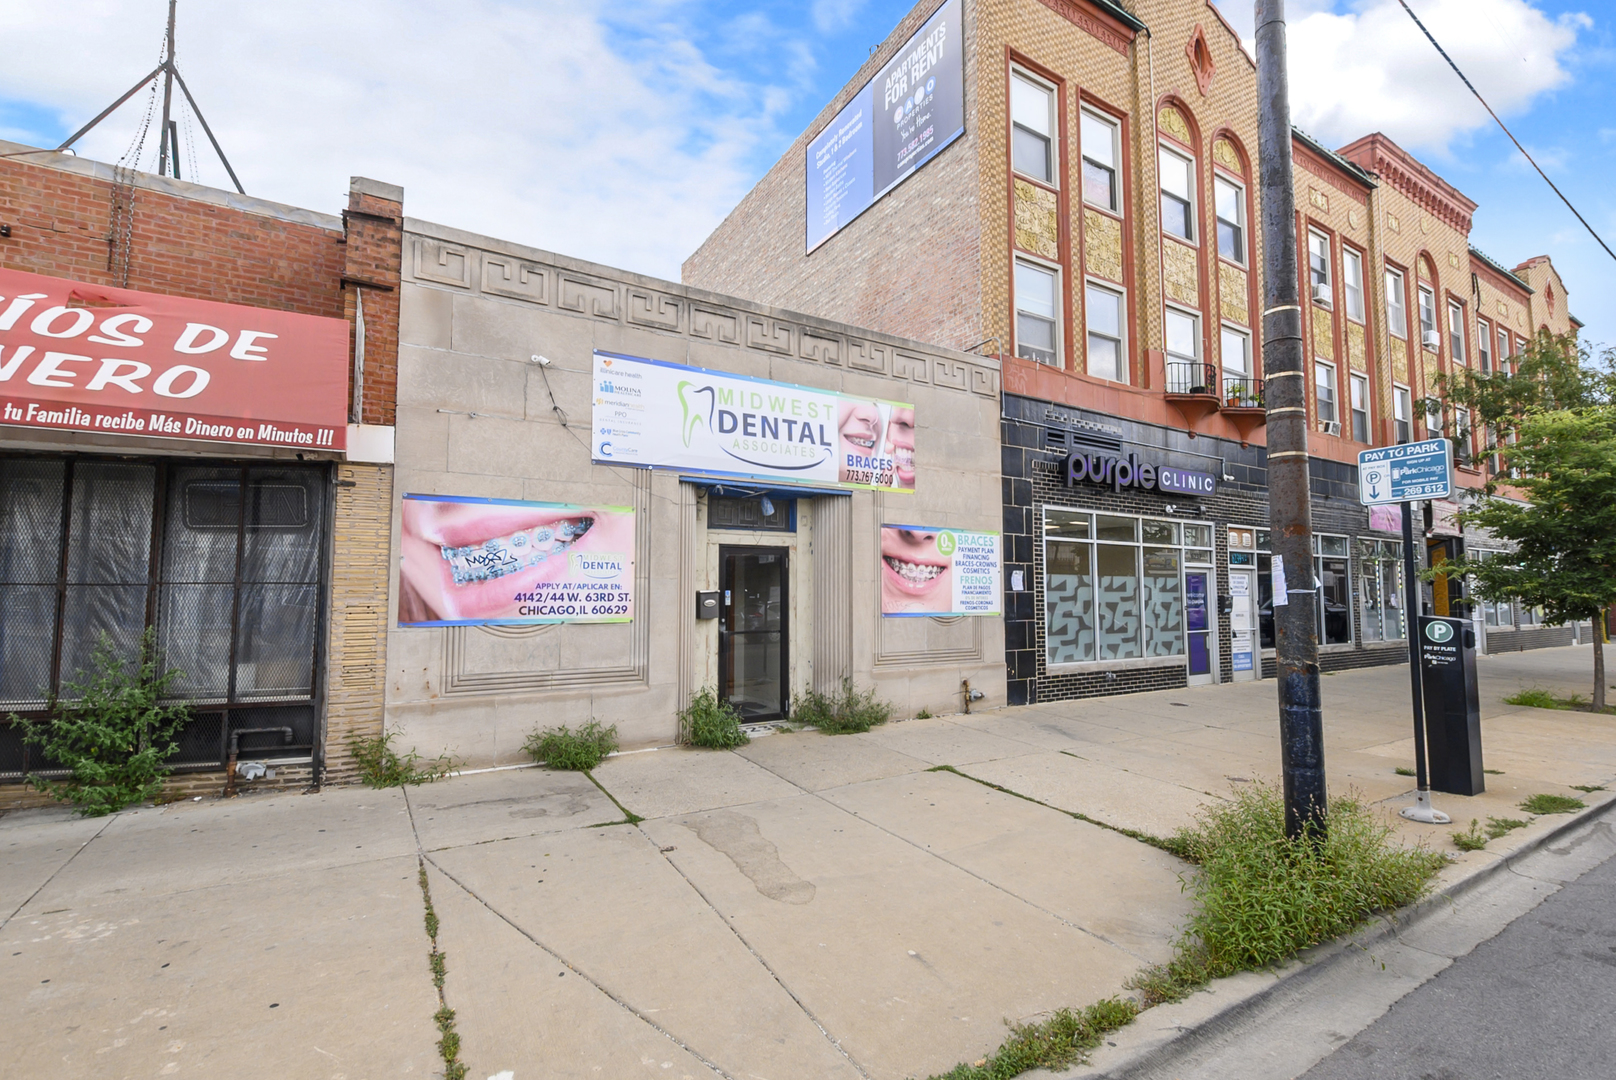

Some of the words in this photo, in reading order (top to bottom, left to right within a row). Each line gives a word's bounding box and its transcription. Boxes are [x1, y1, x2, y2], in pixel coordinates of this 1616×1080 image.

[885, 21, 946, 92] APARTMENTS
[885, 75, 907, 111] FOR
[911, 35, 946, 86] RENT
[897, 93, 933, 130] PROPERTIES
[0, 293, 153, 347] ÍOS
[173, 322, 279, 361] DE
[614, 385, 641, 394] MOLINA
[718, 387, 834, 421] MIDWEST
[4, 402, 23, 421] tu
[25, 403, 91, 427] Familia
[94, 411, 145, 430] recibe
[149, 414, 182, 433] Más
[185, 418, 234, 438] Dinero
[236, 427, 254, 440] en
[257, 425, 313, 444] Minutos
[718, 409, 832, 447] DENTAL
[732, 438, 815, 458] ASSOCIATES
[1365, 451, 1385, 462] PAY
[1388, 448, 1404, 458] TO
[1407, 442, 1439, 455] PARK
[846, 454, 893, 471] BRACES
[1400, 465, 1444, 475] ParkChicago
[846, 470, 893, 485] 773.767.6000
[1067, 452, 1156, 493] purple
[1162, 471, 1213, 492] CLINIC
[1404, 486, 1422, 496] 269
[1424, 484, 1444, 493] 612
[958, 534, 994, 547] BRACES
[583, 561, 622, 570] DENTAL
[960, 576, 993, 585] FRENOS
[514, 592, 565, 603] 4142/44
[567, 592, 581, 602] W.
[585, 592, 614, 602] 63RD
[617, 592, 632, 602] ST.
[518, 605, 588, 616] CHICAGO,IL
[591, 605, 628, 615] 60629
[1434, 624, 1447, 639] P
